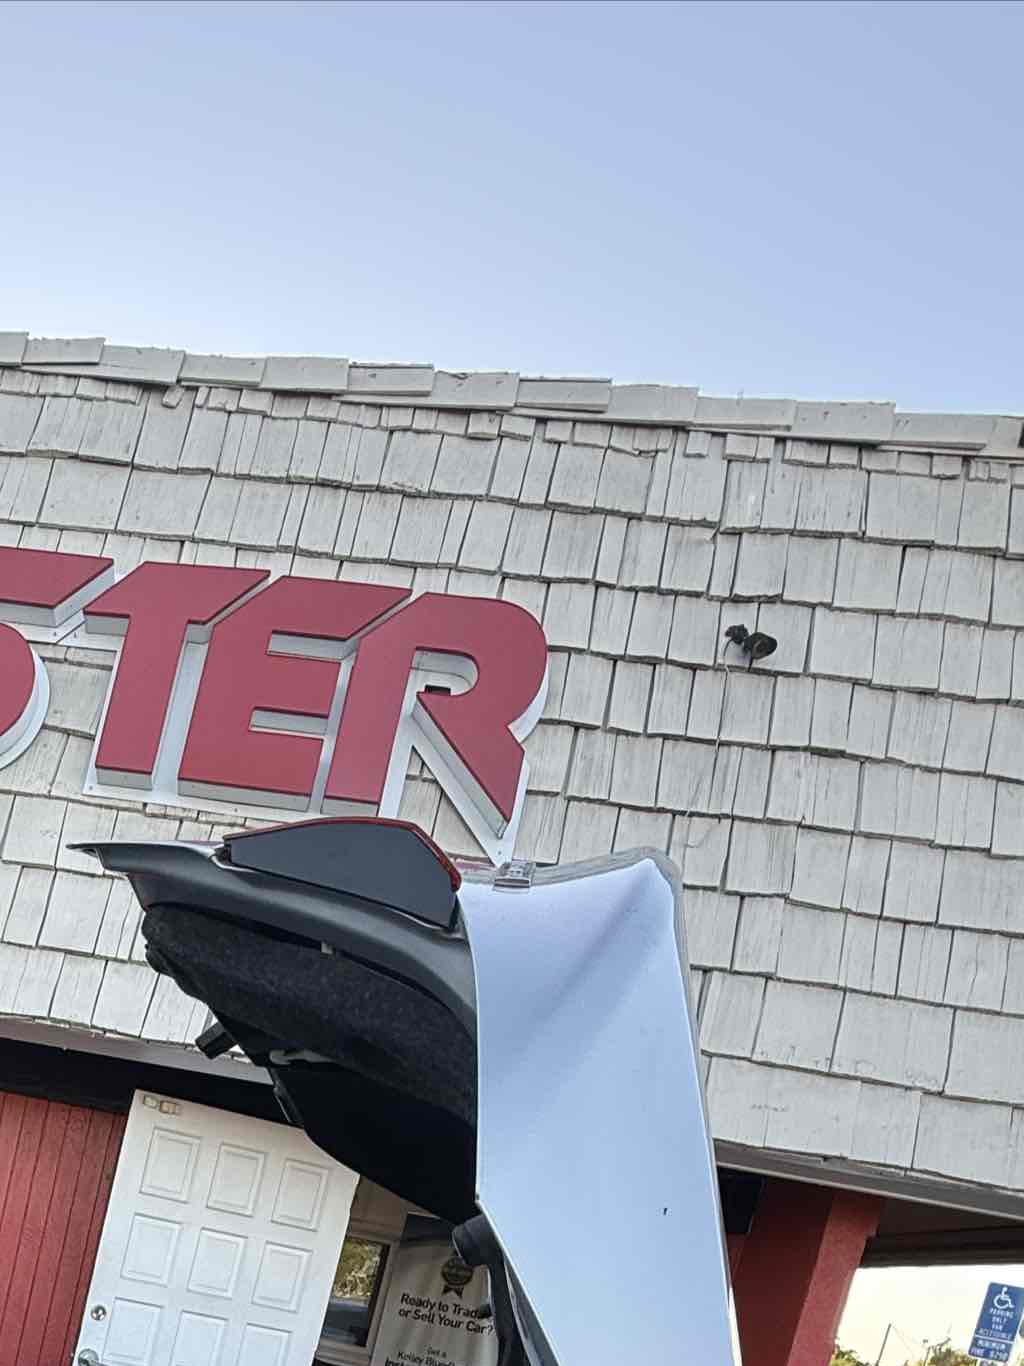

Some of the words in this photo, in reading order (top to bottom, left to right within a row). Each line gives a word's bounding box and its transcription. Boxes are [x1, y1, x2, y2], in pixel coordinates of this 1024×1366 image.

[400, 1293, 436, 1312] Ready
[438, 1301, 449, 1313] to
[399, 1308, 411, 1318] or
[412, 1309, 435, 1324] Sell
[438, 1313, 464, 1329] Your
[466, 1320, 494, 1335] Car?
